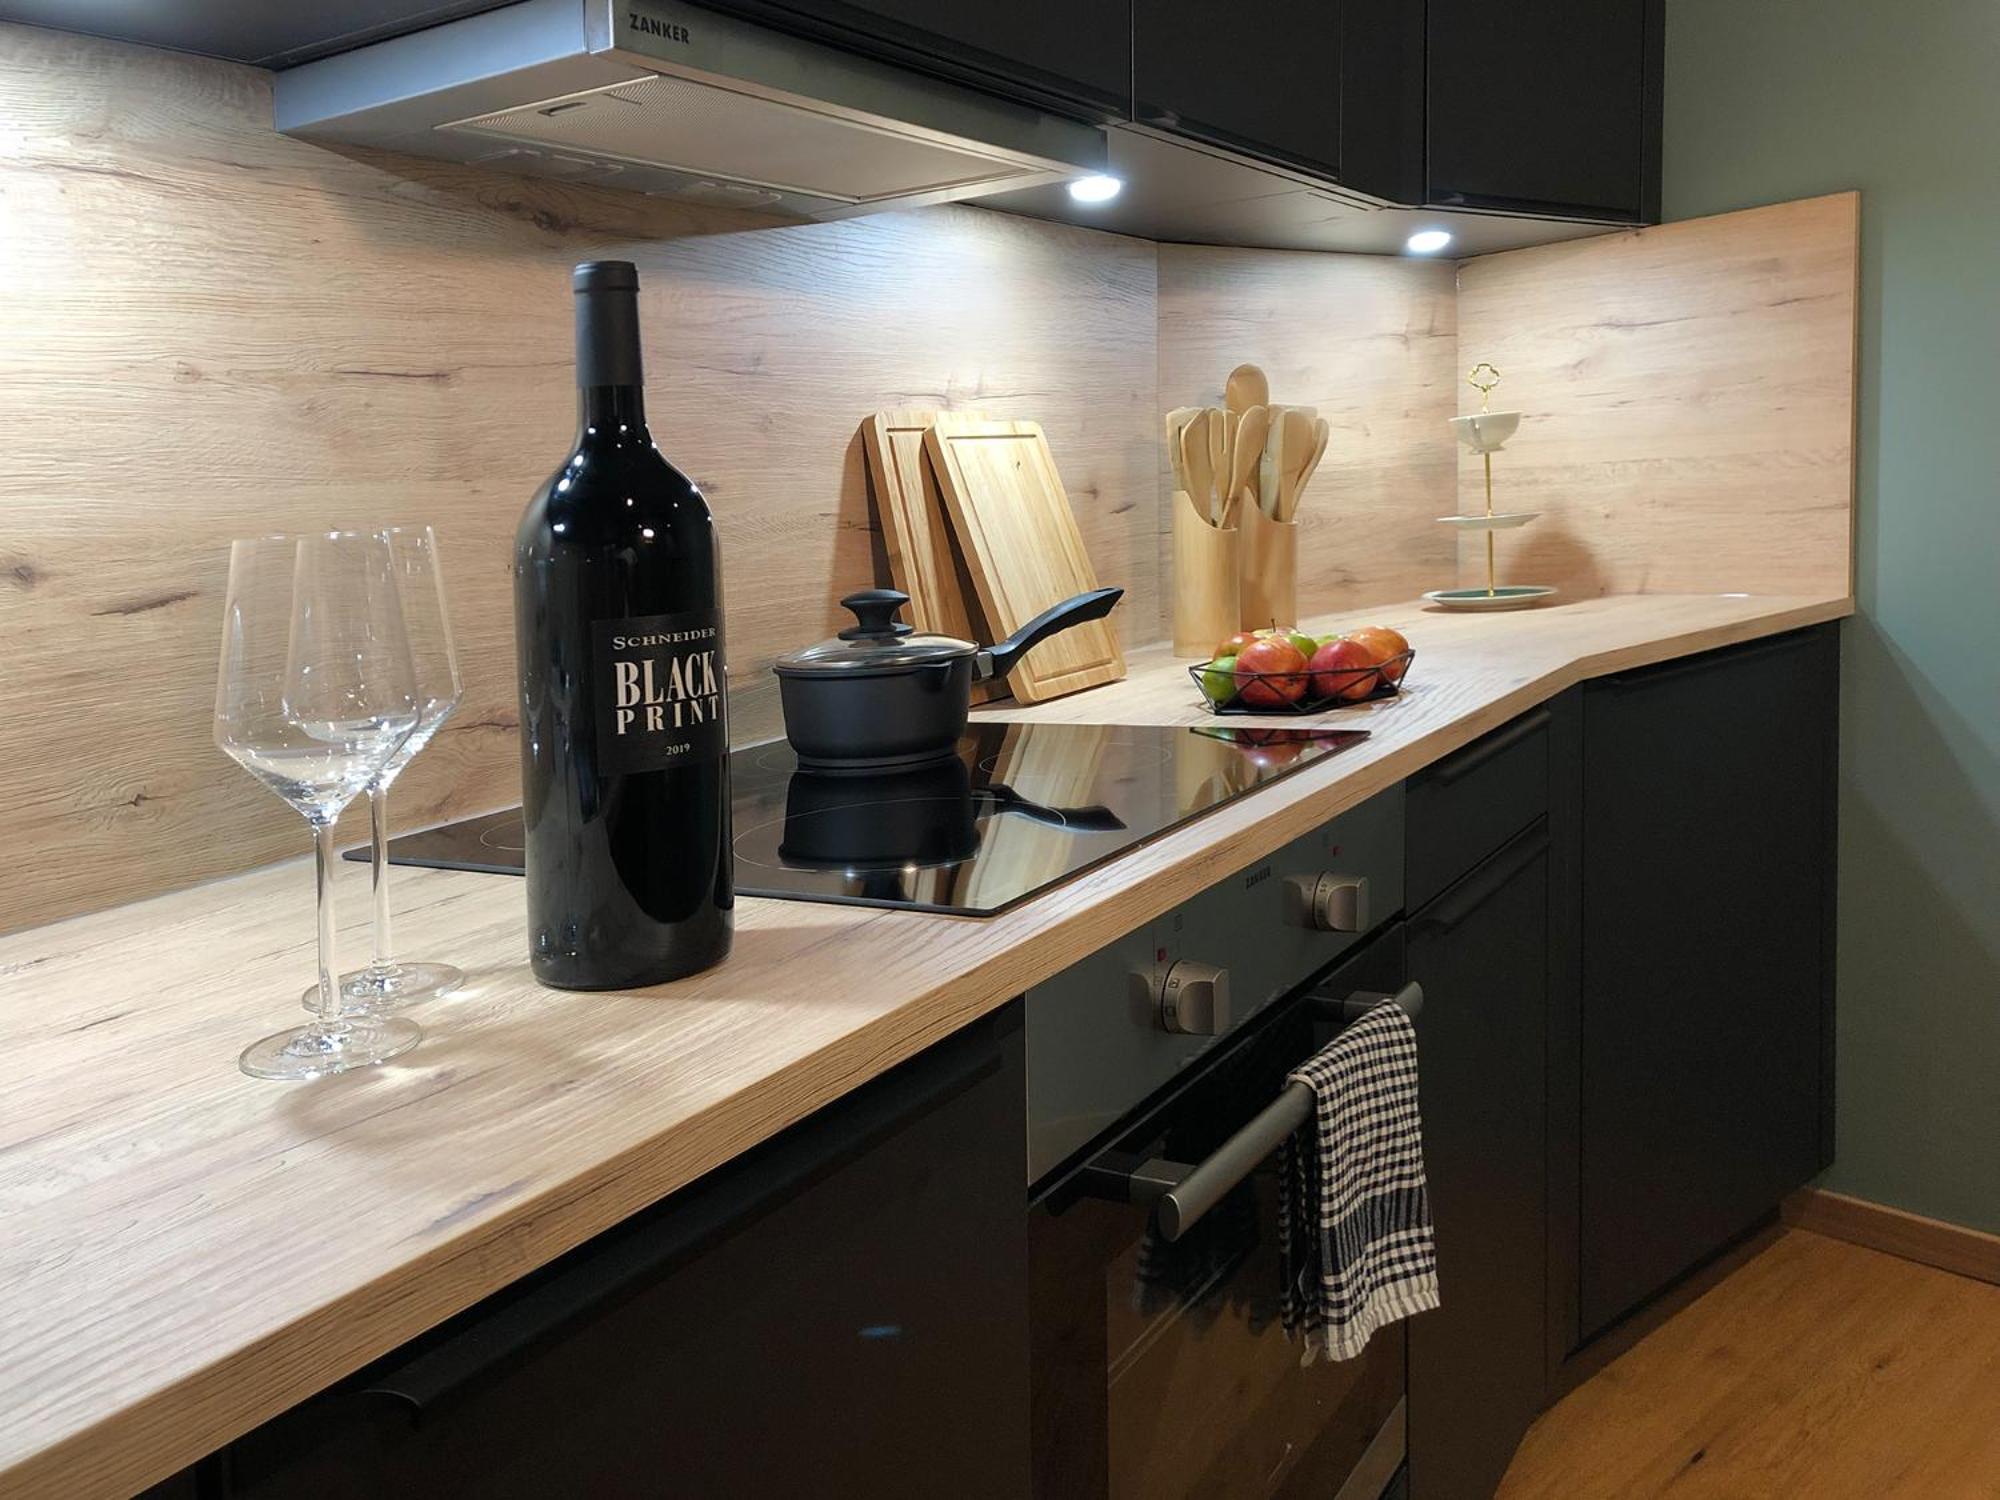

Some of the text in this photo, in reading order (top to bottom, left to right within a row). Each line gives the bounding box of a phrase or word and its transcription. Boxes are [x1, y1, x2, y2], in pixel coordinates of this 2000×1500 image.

[629, 13, 689, 44] ZANKER
[612, 627, 716, 650] SCHNEIDER
[614, 650, 719, 708] BLACK
[616, 694, 719, 735] PRINT
[665, 743, 691, 756] 2019
